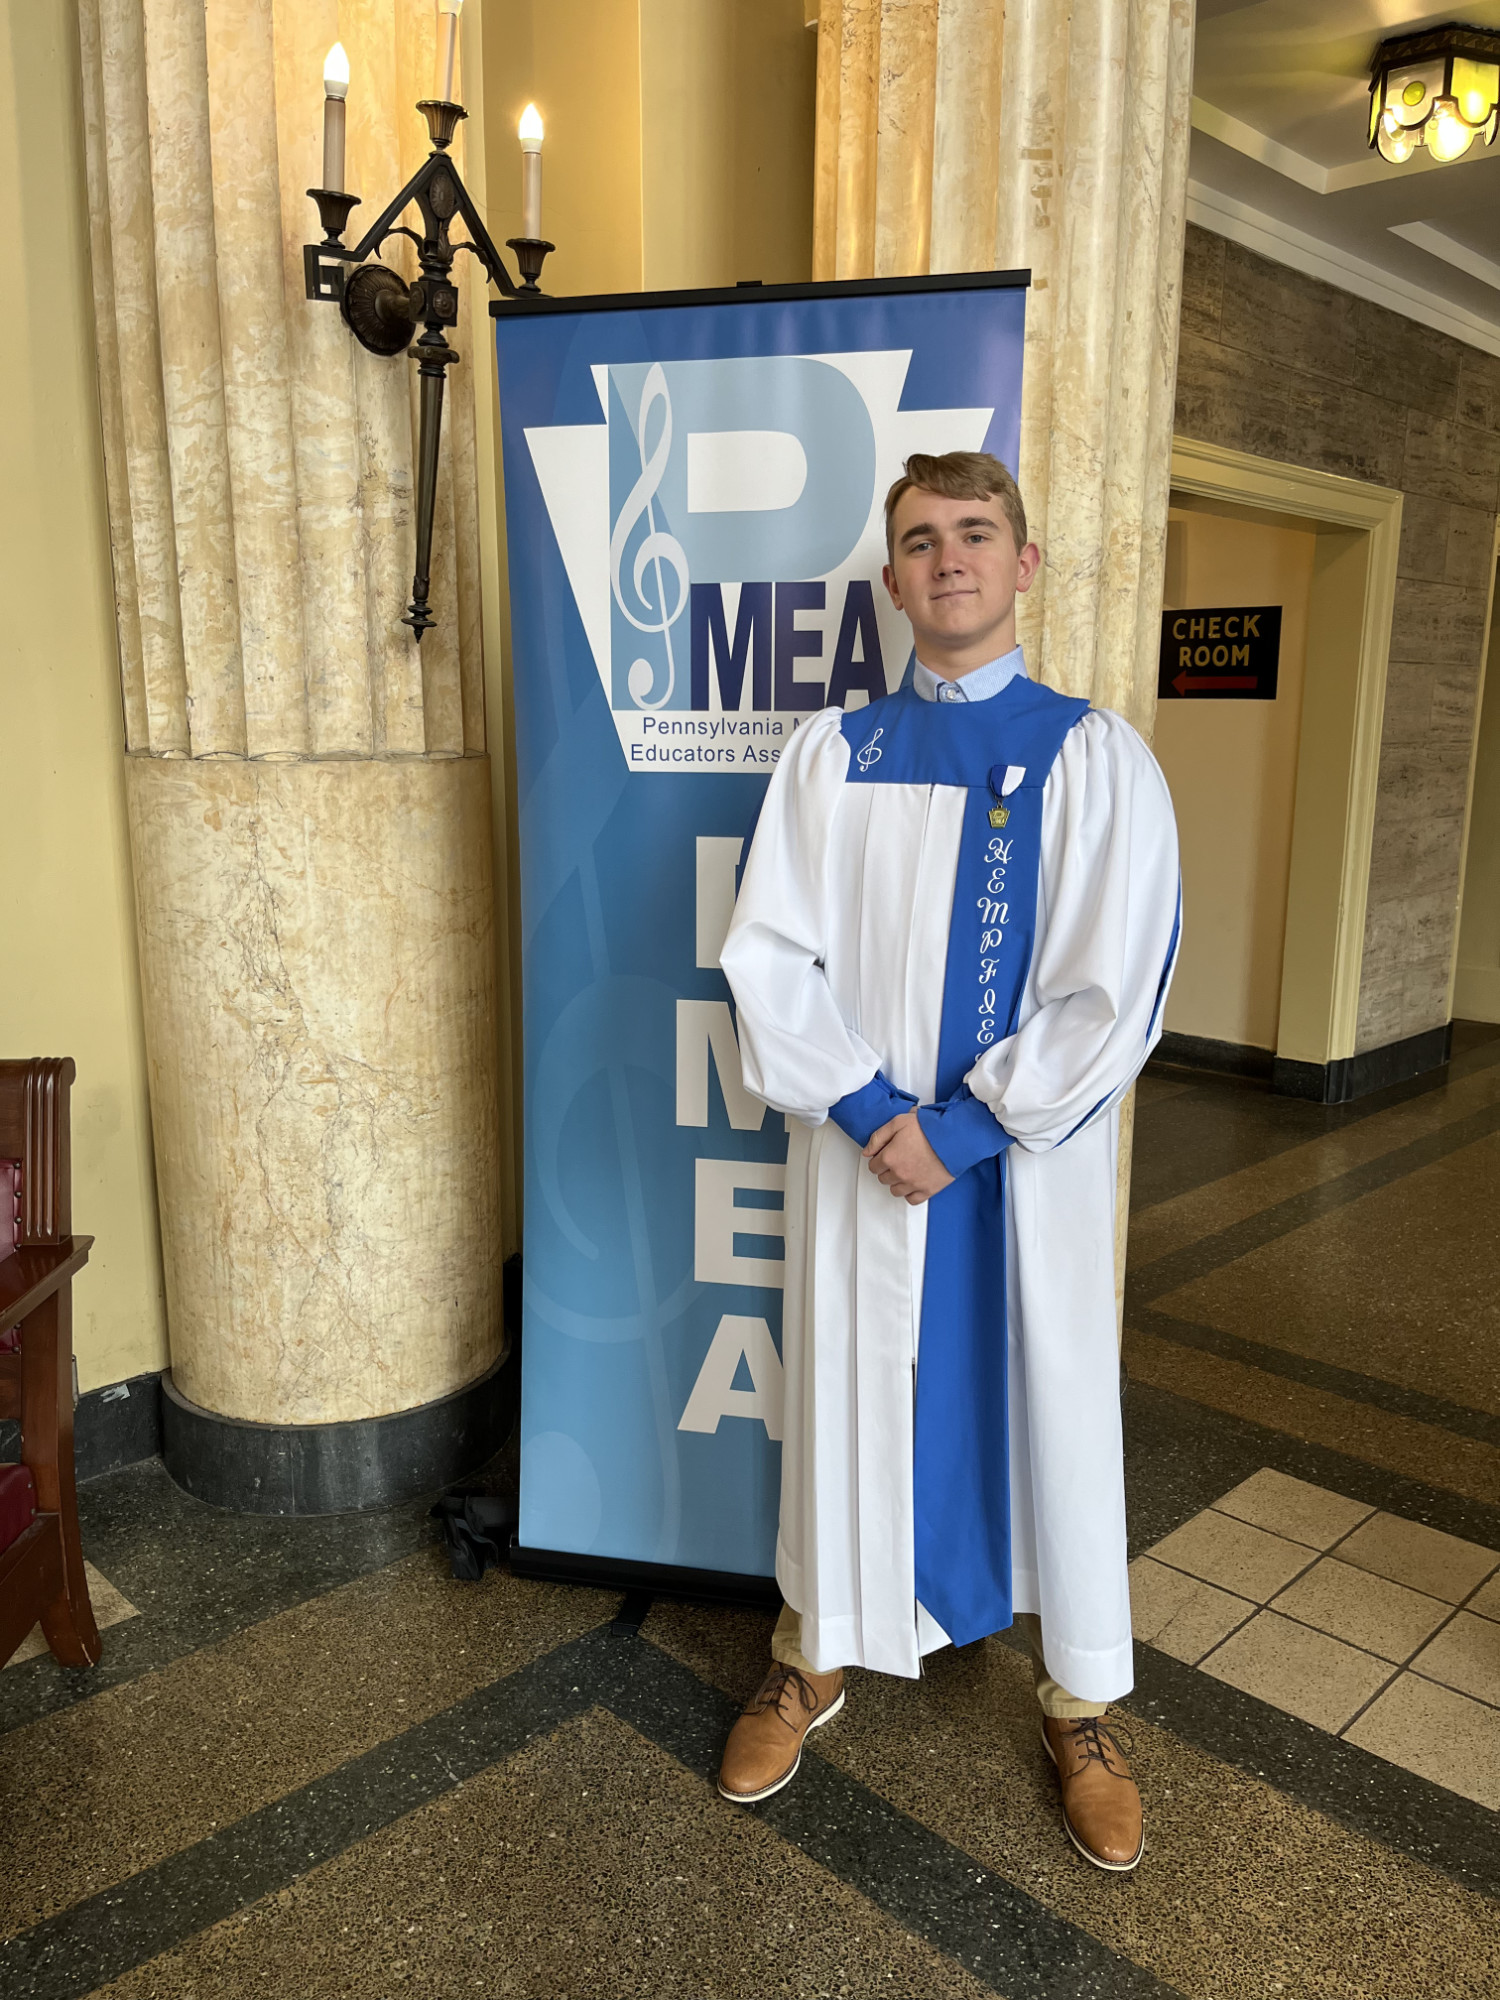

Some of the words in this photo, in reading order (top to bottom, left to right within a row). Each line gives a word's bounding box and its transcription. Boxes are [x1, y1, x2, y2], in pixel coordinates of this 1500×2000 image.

[1172, 614, 1261, 640] CHECK
[1179, 644, 1250, 667] ROOM
[643, 716, 783, 739] Pennsylvania
[631, 743, 735, 762] Educators
[742, 744, 781, 762] Ass
[975, 837, 1013, 1062] HEMPFIE
